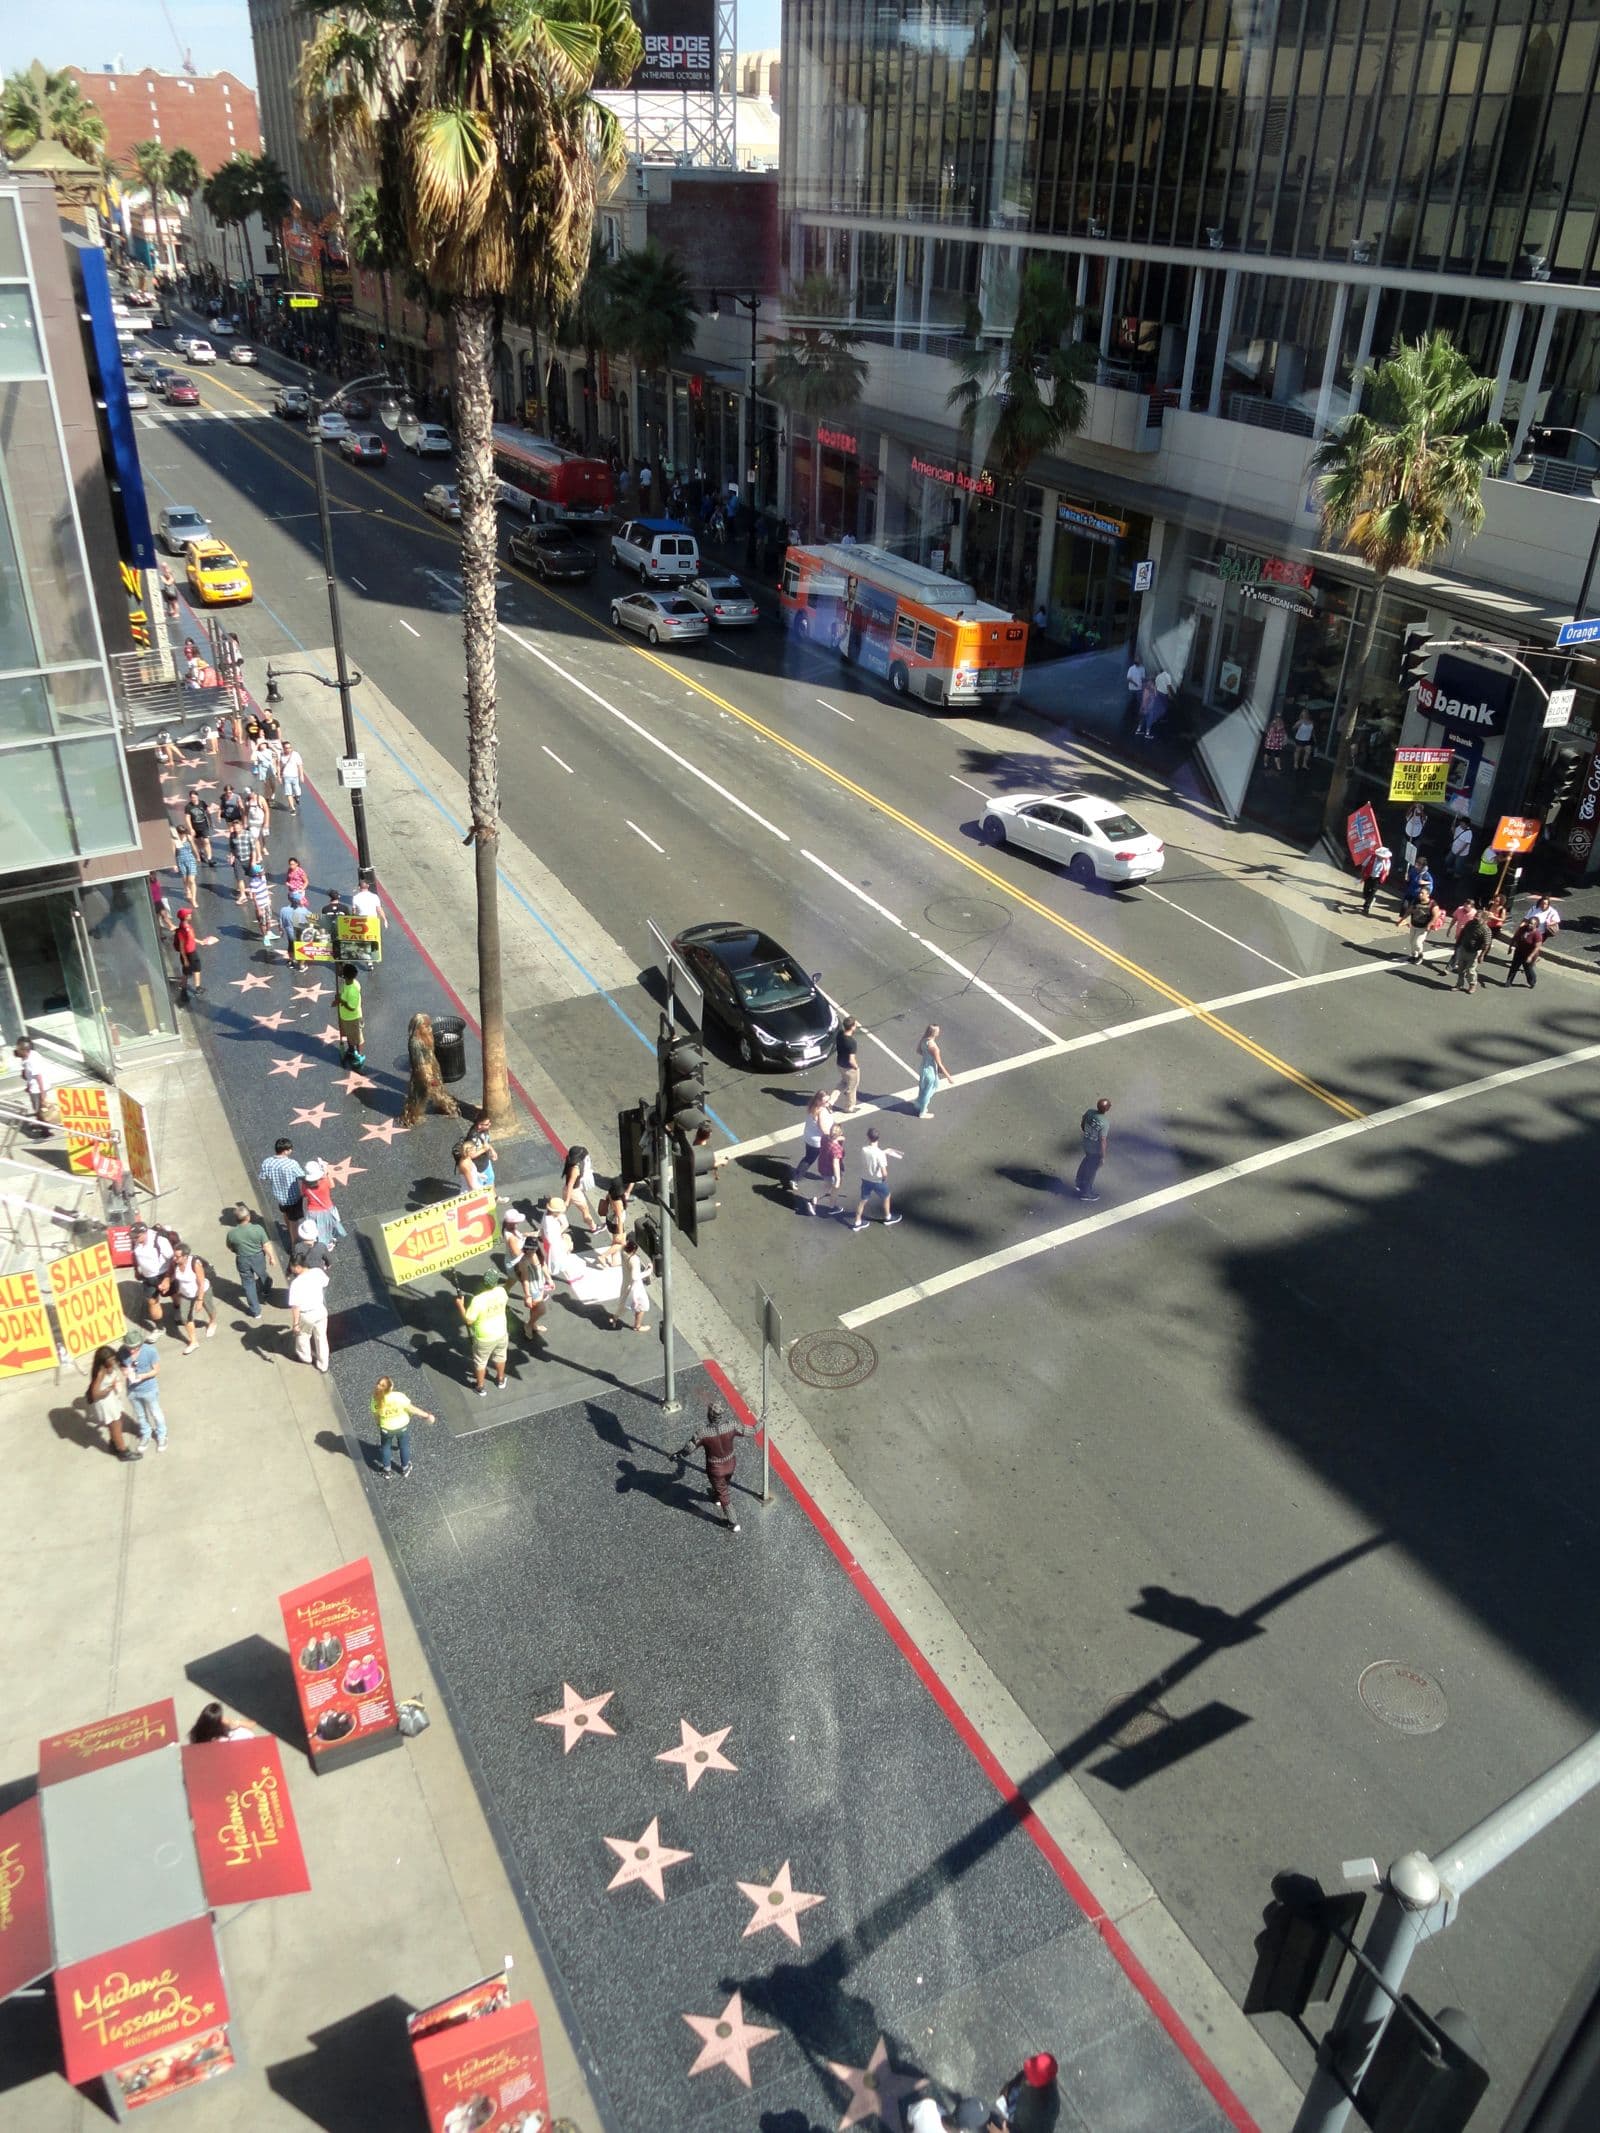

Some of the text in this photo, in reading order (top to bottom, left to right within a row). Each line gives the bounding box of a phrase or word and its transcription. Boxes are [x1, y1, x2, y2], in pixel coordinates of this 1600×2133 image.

[645, 35, 710, 52] BRIDGE
[646, 52, 710, 68] OF SPIES
[641, 72, 649, 80] IN
[676, 72, 702, 80] OCTOBER
[817, 427, 857, 454] HOOTERS
[911, 456, 995, 496] American Apparel
[1219, 556, 1315, 590] BAJA FRESH
[1009, 629, 1021, 639] 217
[1566, 626, 1599, 640] Orange
[1548, 707, 1569, 716] BLOCK
[1398, 751, 1433, 763] REPENT
[1403, 764, 1441, 773] BELIEVE IN
[1393, 781, 1445, 791] JESUS CHRIST
[1404, 773, 1437, 781] THE LORD
[57, 1088, 110, 1118] SALE
[63, 1121, 113, 1148] TODAY
[439, 1238, 499, 1269] PRODUCTS
[51, 1244, 111, 1294] SALE
[0, 1273, 40, 1309] ALE
[58, 1279, 115, 1326] TODAY
[0, 1308, 44, 1344] ODAY
[68, 1310, 125, 1354] ONLY!
[296, 1596, 352, 1619] Madame
[300, 1604, 362, 1629] Tussauds
[218, 1789, 252, 1867] Madame
[240, 1775, 279, 1860] Tussauds
[73, 1967, 180, 2020] Madame
[81, 1986, 202, 2047] Tussauds
